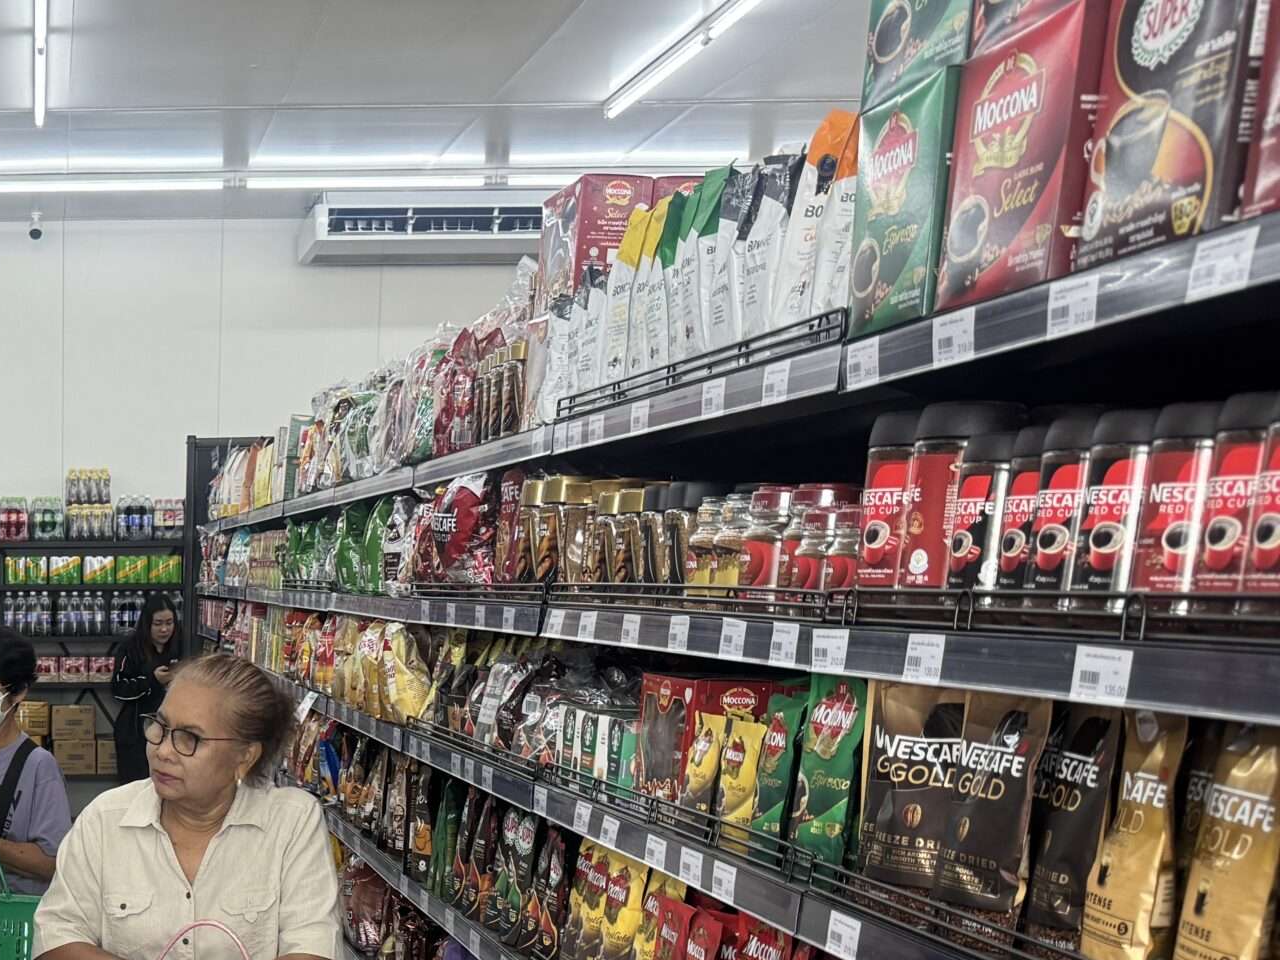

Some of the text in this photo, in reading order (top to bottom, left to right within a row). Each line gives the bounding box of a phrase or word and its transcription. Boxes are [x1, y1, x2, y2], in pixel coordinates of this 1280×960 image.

[973, 81, 1039, 135] MOCCONA
[869, 138, 914, 182] MOCCONA
[994, 177, 1041, 217] Select
[1160, 503, 1184, 514] RED
[723, 695, 755, 706] MOCCONA
[884, 734, 961, 764] NESCAF
[960, 738, 1026, 778] NESCAFE
[959, 772, 1006, 801] GOLD
